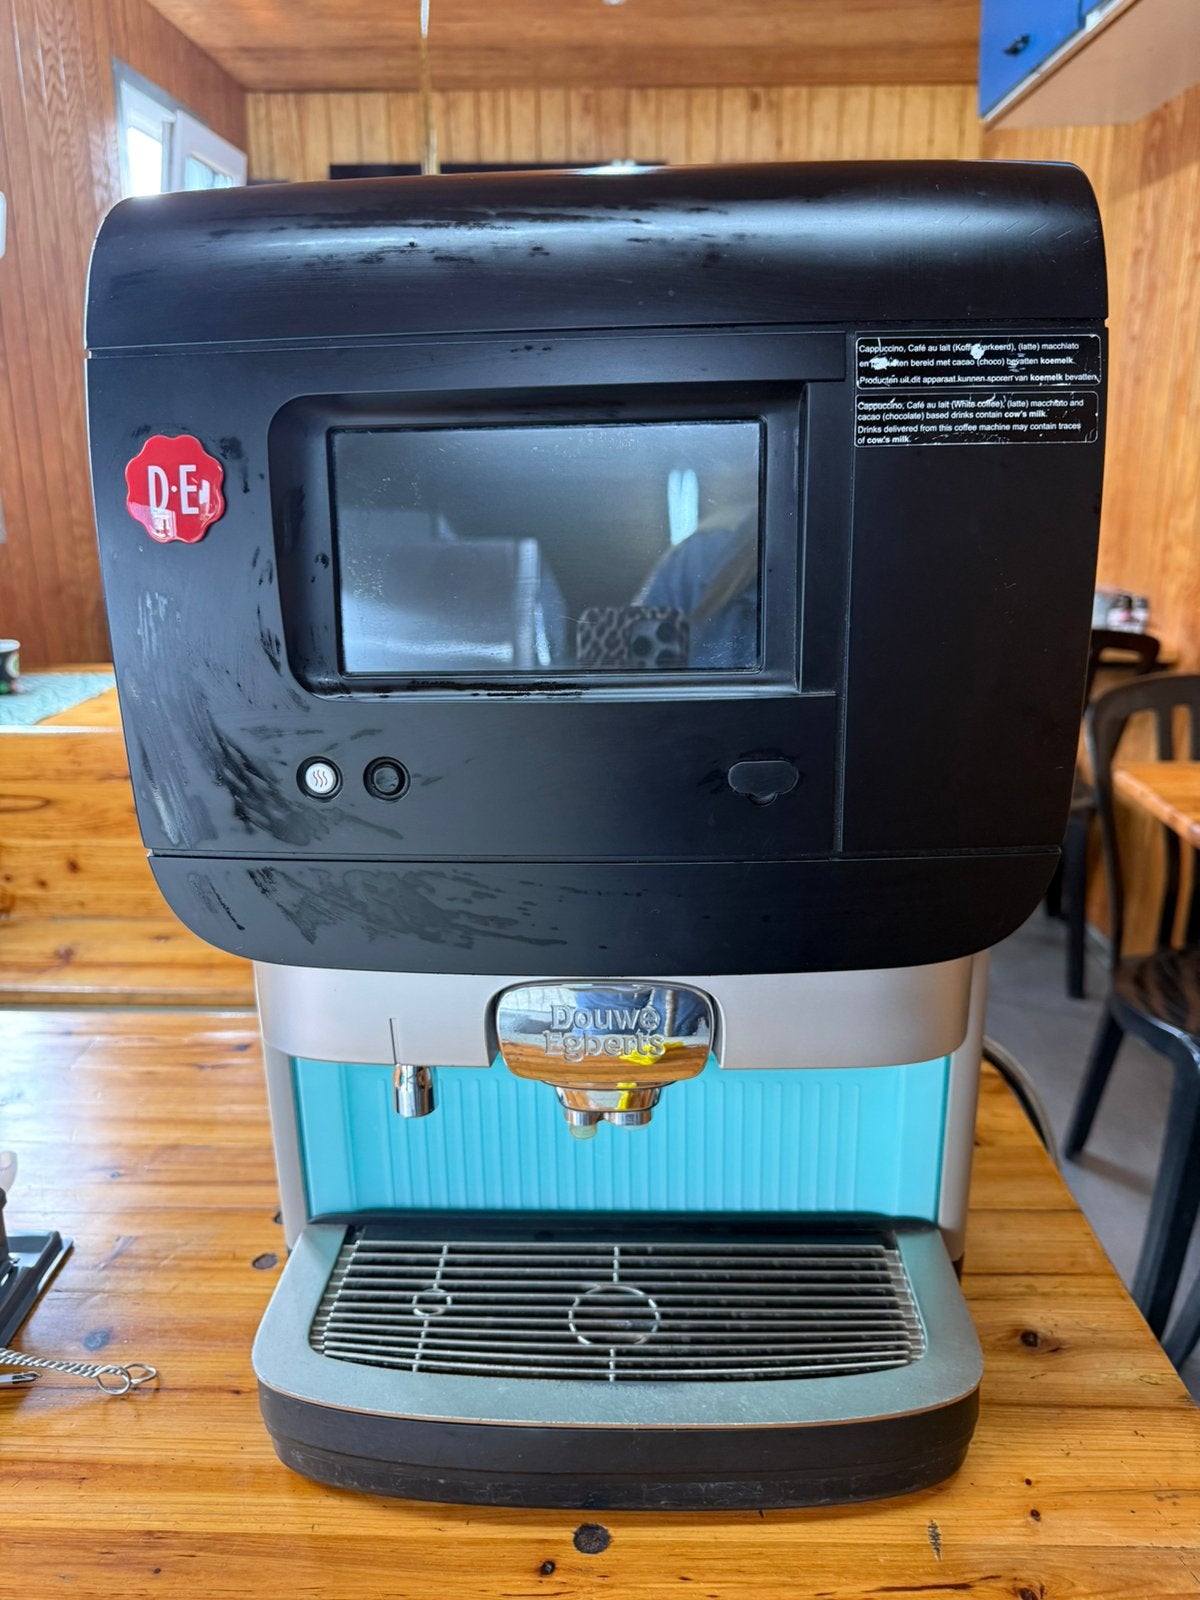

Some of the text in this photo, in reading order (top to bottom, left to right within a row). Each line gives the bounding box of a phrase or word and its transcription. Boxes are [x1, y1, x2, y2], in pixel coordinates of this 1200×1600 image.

[859, 344, 906, 354] Cappuccino,
[908, 344, 926, 353] Café
[939, 344, 951, 352] lait
[1018, 342, 1040, 352] (latte)
[1041, 342, 1080, 350] macchiato
[910, 358, 935, 367] bereid
[936, 358, 951, 366] met
[976, 357, 1005, 367] (choco)
[859, 376, 898, 385] Producten
[911, 376, 921, 384] dit
[922, 376, 956, 385] apparaat
[957, 374, 985, 383] kunnen
[1015, 374, 1029, 382] van
[1030, 373, 1063, 381] koemelk
[857, 401, 905, 411] Cappuccino,
[906, 401, 925, 409] Café
[938, 400, 950, 409] lait
[951, 399, 976, 409] (White
[1007, 399, 1030, 409] (latte)
[1030, 398, 1069, 407] macchiato
[1069, 398, 1084, 407] and
[882, 411, 925, 422] (chocolate)
[925, 411, 950, 419] based
[950, 410, 974, 419] drinks
[975, 410, 1003, 418] contain
[1004, 410, 1028, 418] cow's
[857, 421, 1082, 433] Drinks delivered from this coffee machine may contain traces
[857, 436, 866, 444] of
[866, 436, 891, 444] cow's
[550, 1004, 661, 1031] Douwe
[543, 1029, 666, 1062] Egberts
